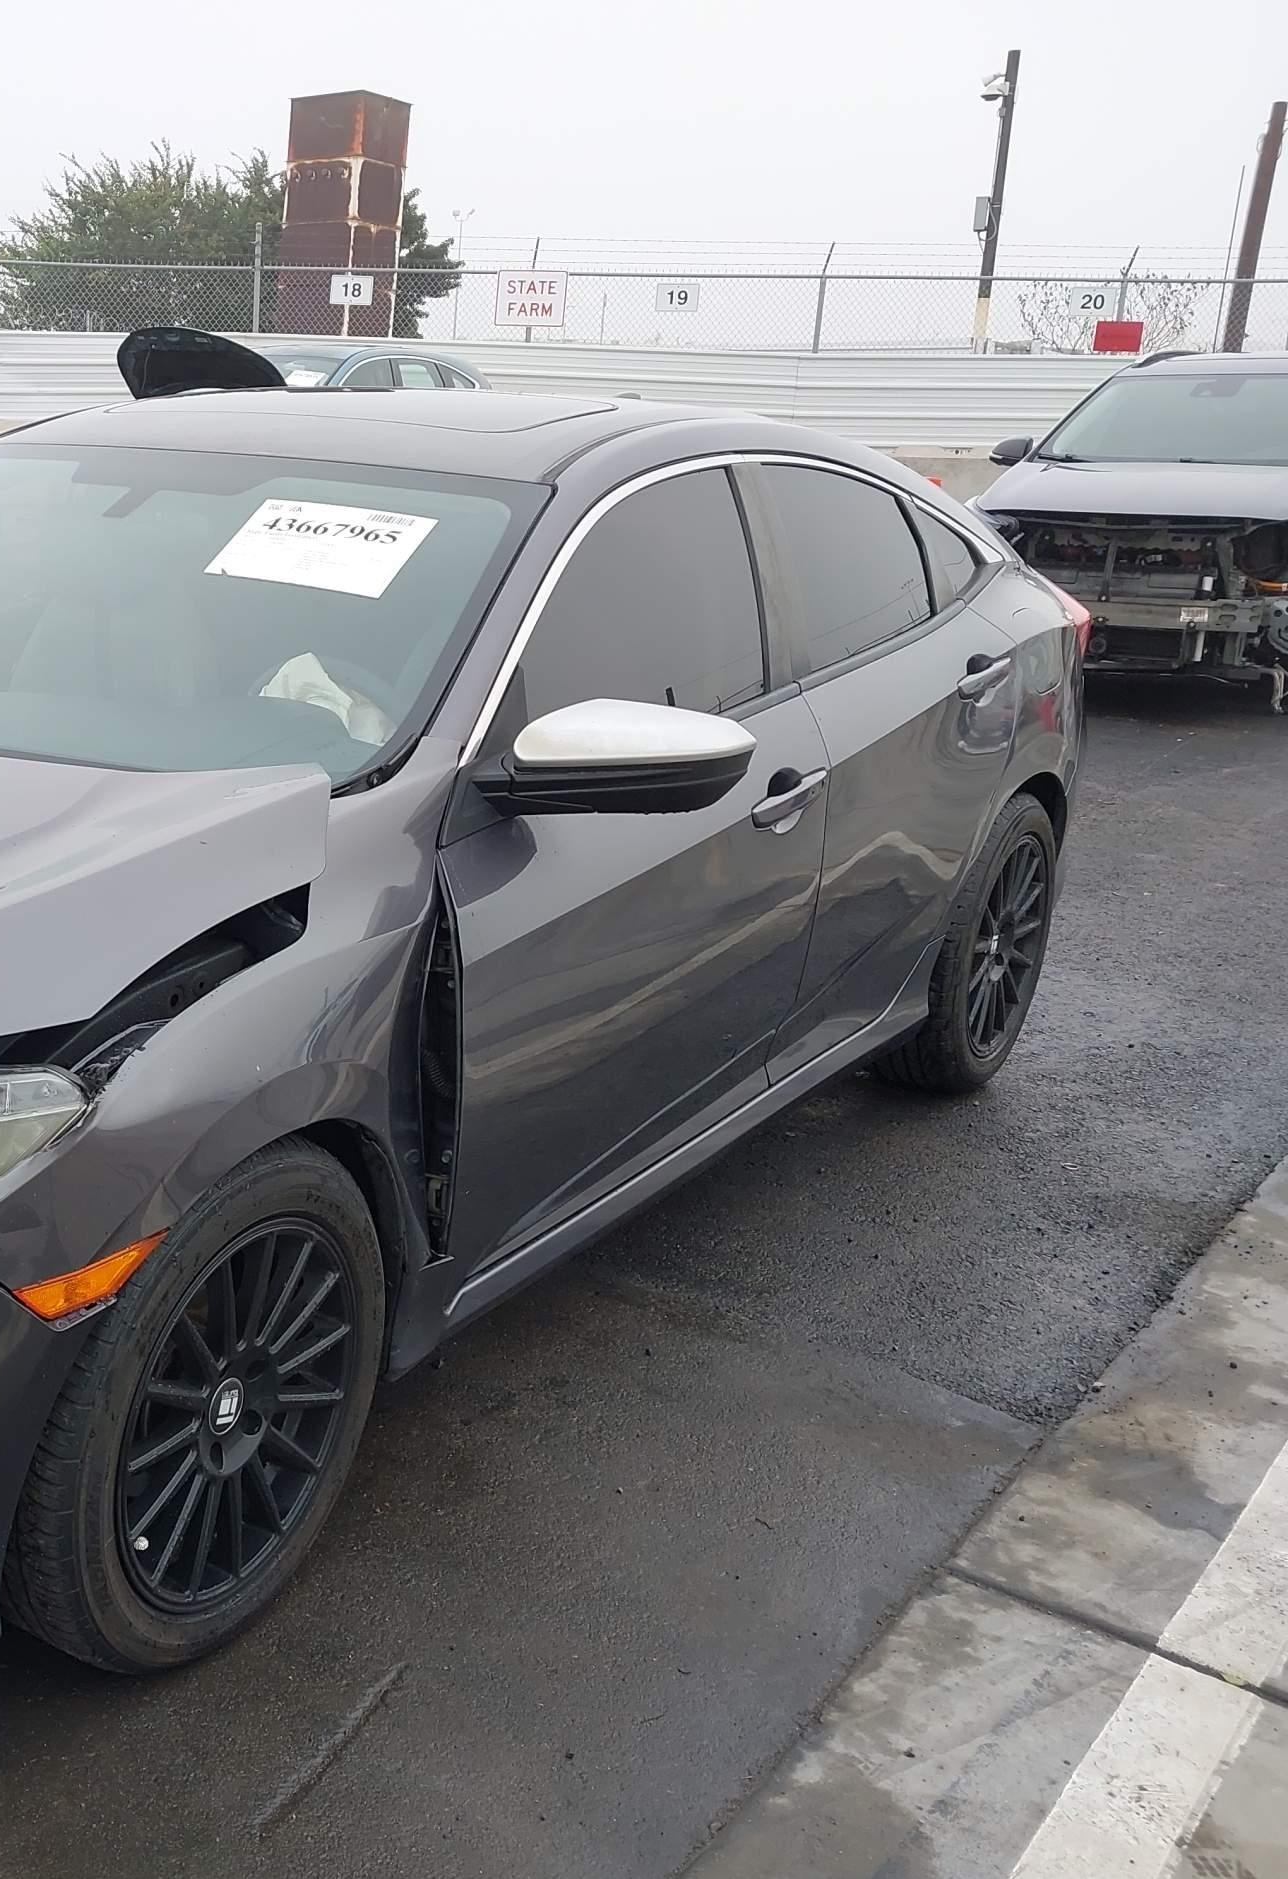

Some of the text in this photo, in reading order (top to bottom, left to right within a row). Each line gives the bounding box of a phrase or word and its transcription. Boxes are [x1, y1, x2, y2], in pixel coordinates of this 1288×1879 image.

[341, 282, 362, 298] 18
[506, 279, 558, 295] STATE
[666, 290, 689, 306] 19
[1079, 293, 1106, 310] 20
[506, 302, 554, 318] FARM
[263, 516, 403, 544] 43667965
